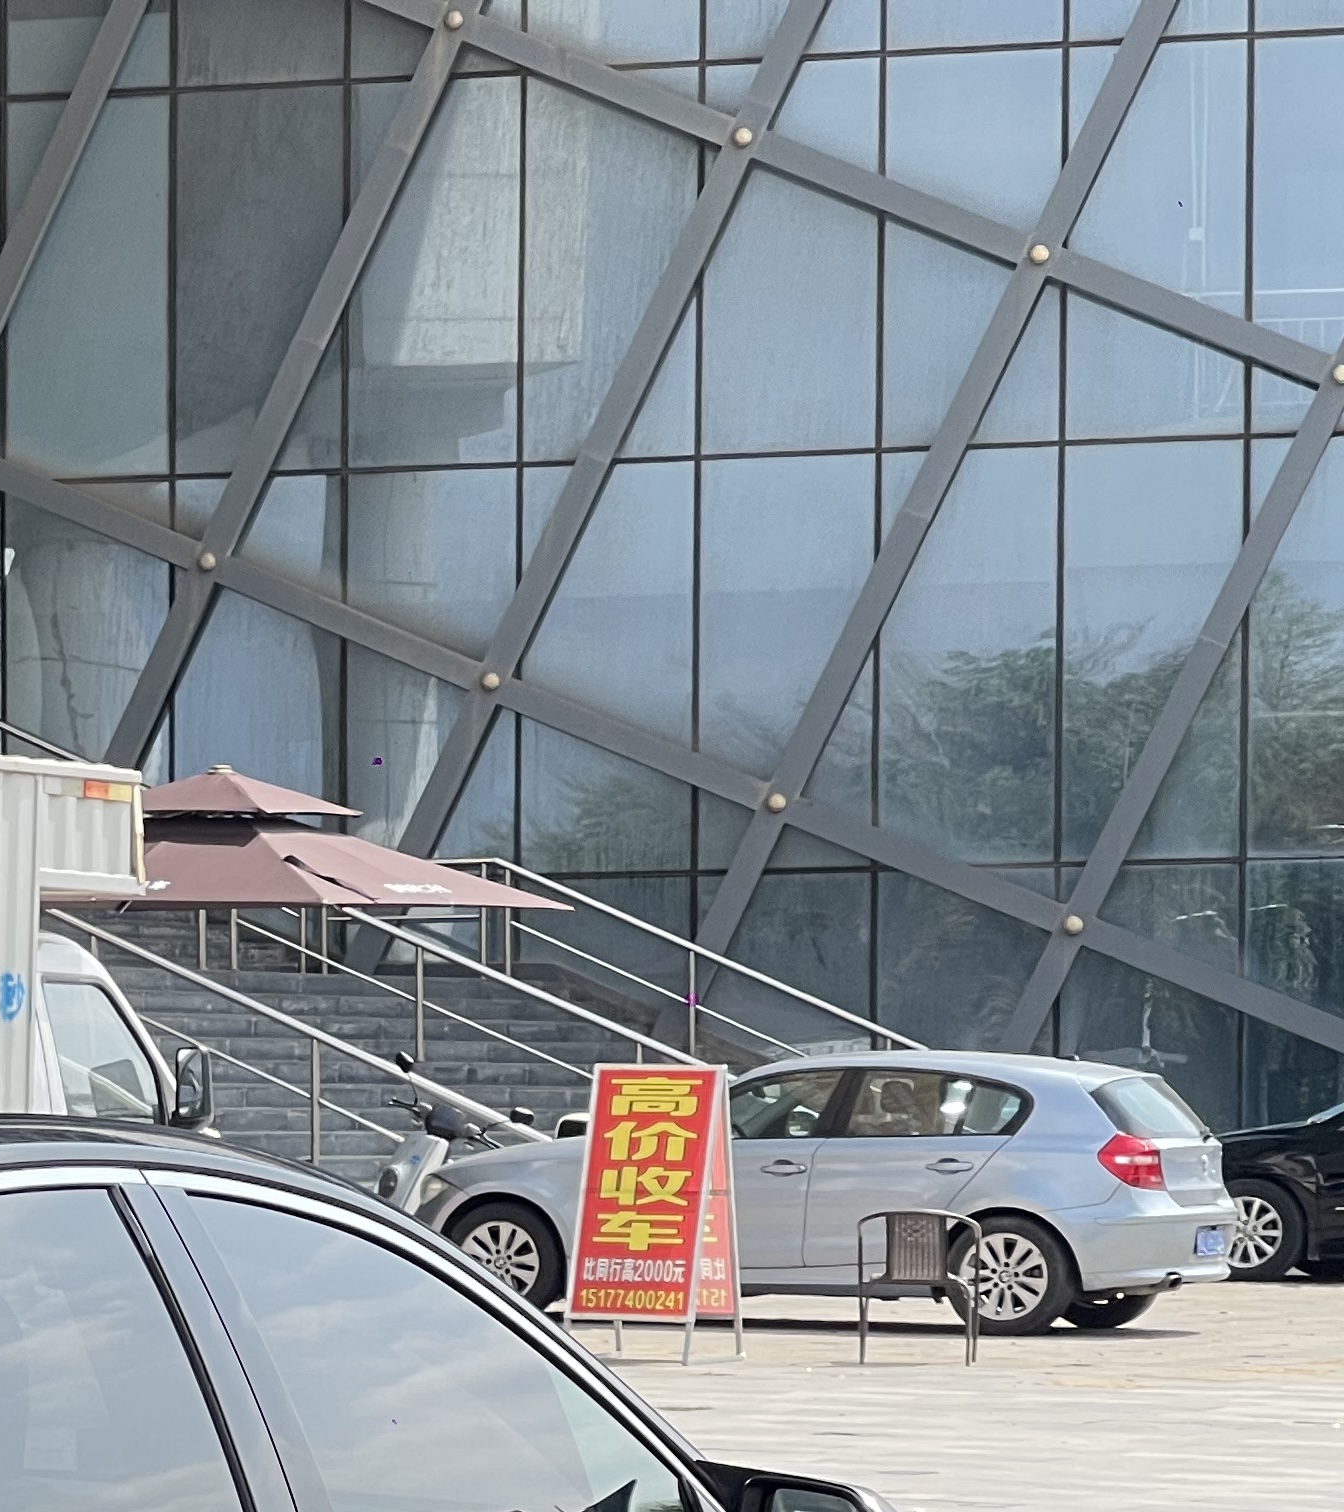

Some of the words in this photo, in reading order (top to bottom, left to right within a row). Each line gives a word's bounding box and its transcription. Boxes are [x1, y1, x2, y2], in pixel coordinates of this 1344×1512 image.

[592, 1076, 704, 1252] 高价收车
[583, 1256, 686, 1284] 比同行高2000元
[579, 1288, 685, 1311] 15177400241
